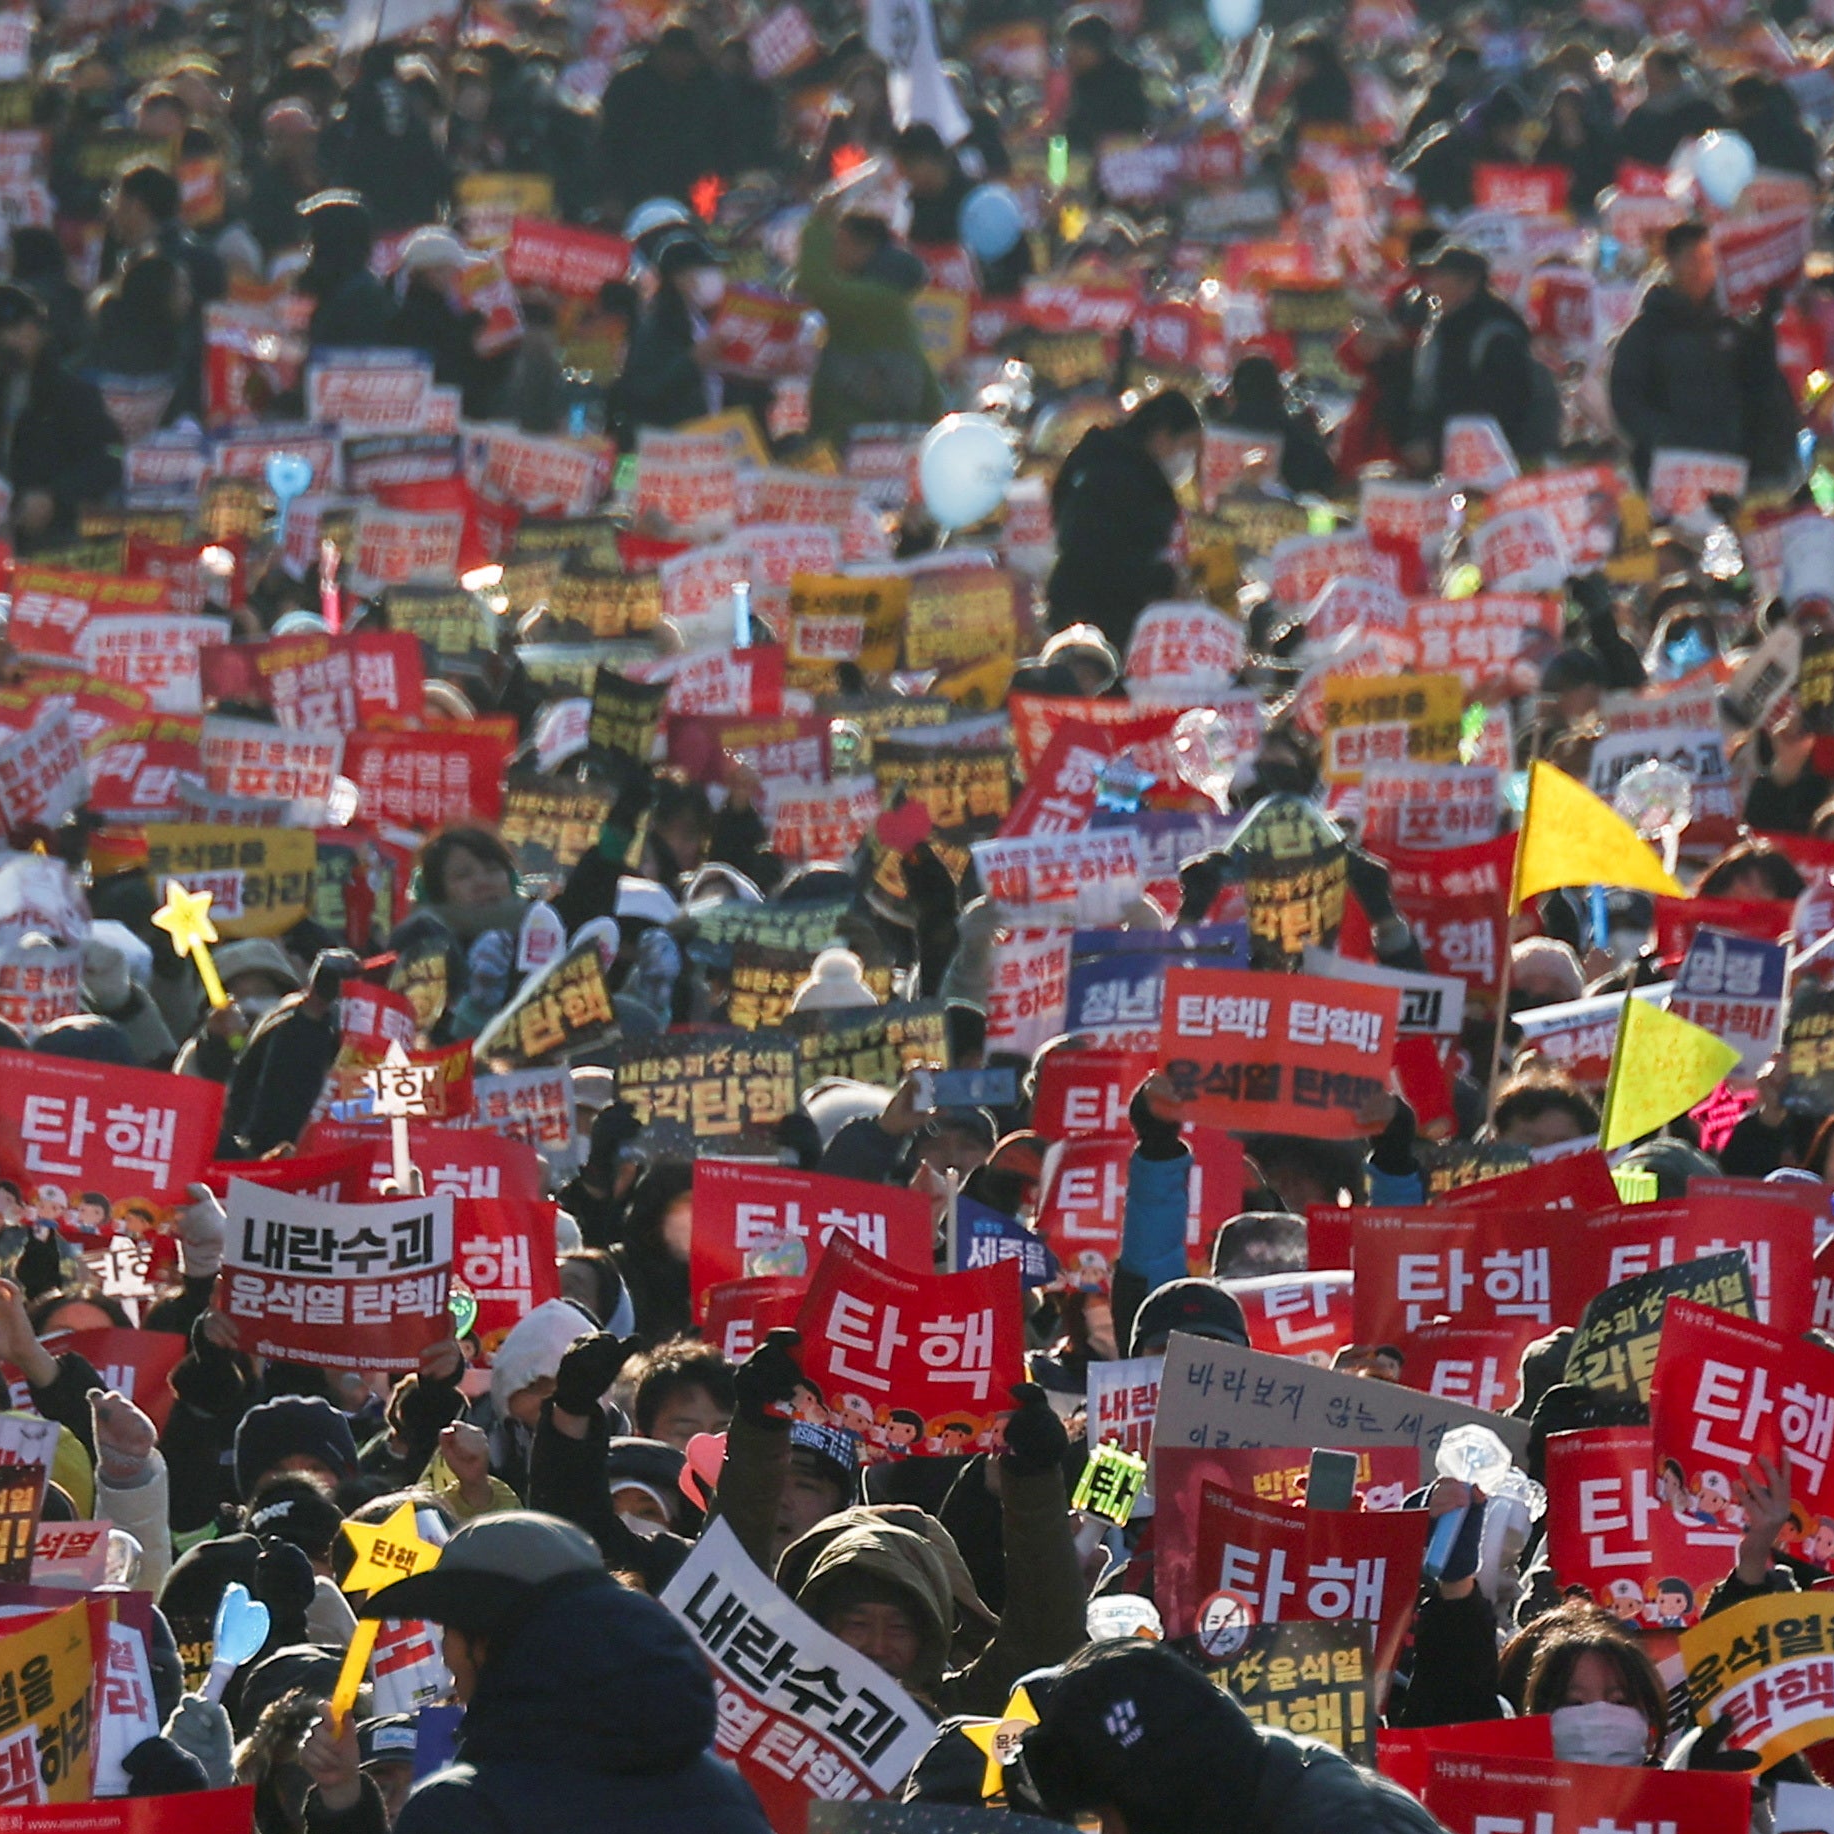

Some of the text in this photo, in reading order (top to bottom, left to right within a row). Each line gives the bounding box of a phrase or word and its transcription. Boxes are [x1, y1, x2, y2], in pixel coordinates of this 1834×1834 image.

[1176, 993, 1383, 1054] 탄핵! 탄핵!
[20, 1095, 178, 1191] 탄핵
[242, 1212, 434, 1276] 내란수괴
[229, 1272, 447, 1324] 윤석열 탄핵!
[1397, 1247, 1552, 1333] 탄핵
[824, 1290, 995, 1401] 탄핵
[1186, 1364, 1385, 1433] 바라보지 않는
[368, 1537, 420, 1571] 탄핵
[1220, 1543, 1386, 1650] 탄핵
[682, 1570, 909, 1769] 내란수괴
[1266, 1645, 1364, 1690] 윤석열
[761, 1718, 874, 1803] 탄핵!
